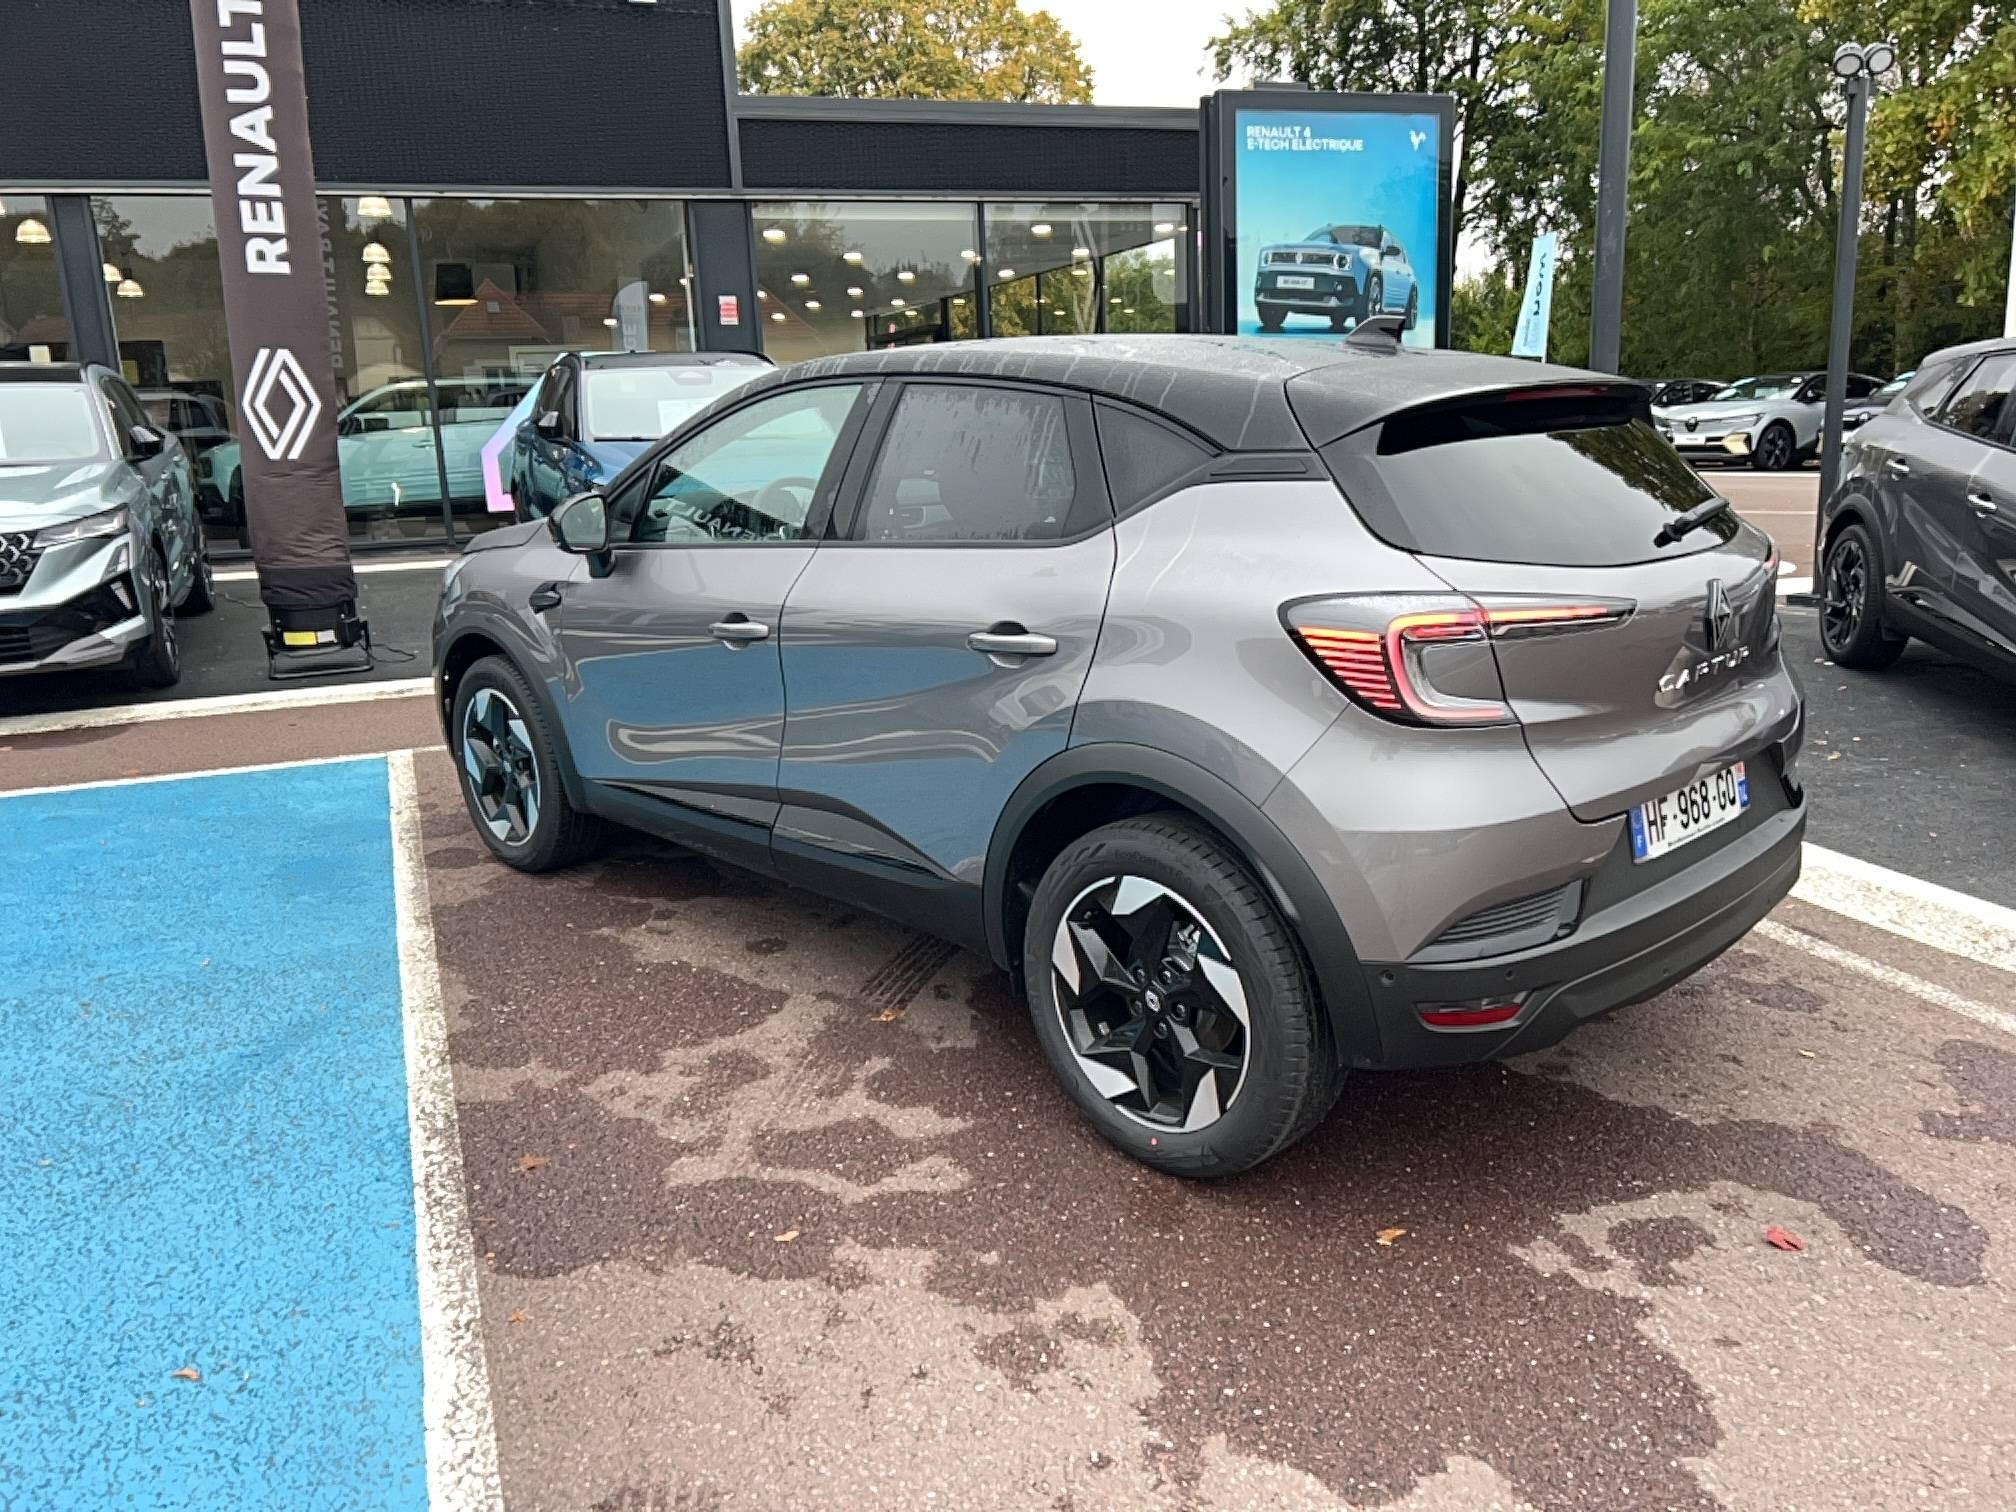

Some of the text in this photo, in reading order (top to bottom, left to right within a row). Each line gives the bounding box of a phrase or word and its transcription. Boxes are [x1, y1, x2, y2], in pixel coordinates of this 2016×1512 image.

[217, 0, 291, 274] RENAULT
[1246, 125, 1301, 137] RENAULT
[1247, 138, 1290, 150] E-TECH
[1659, 646, 1750, 692] CAPTUR
